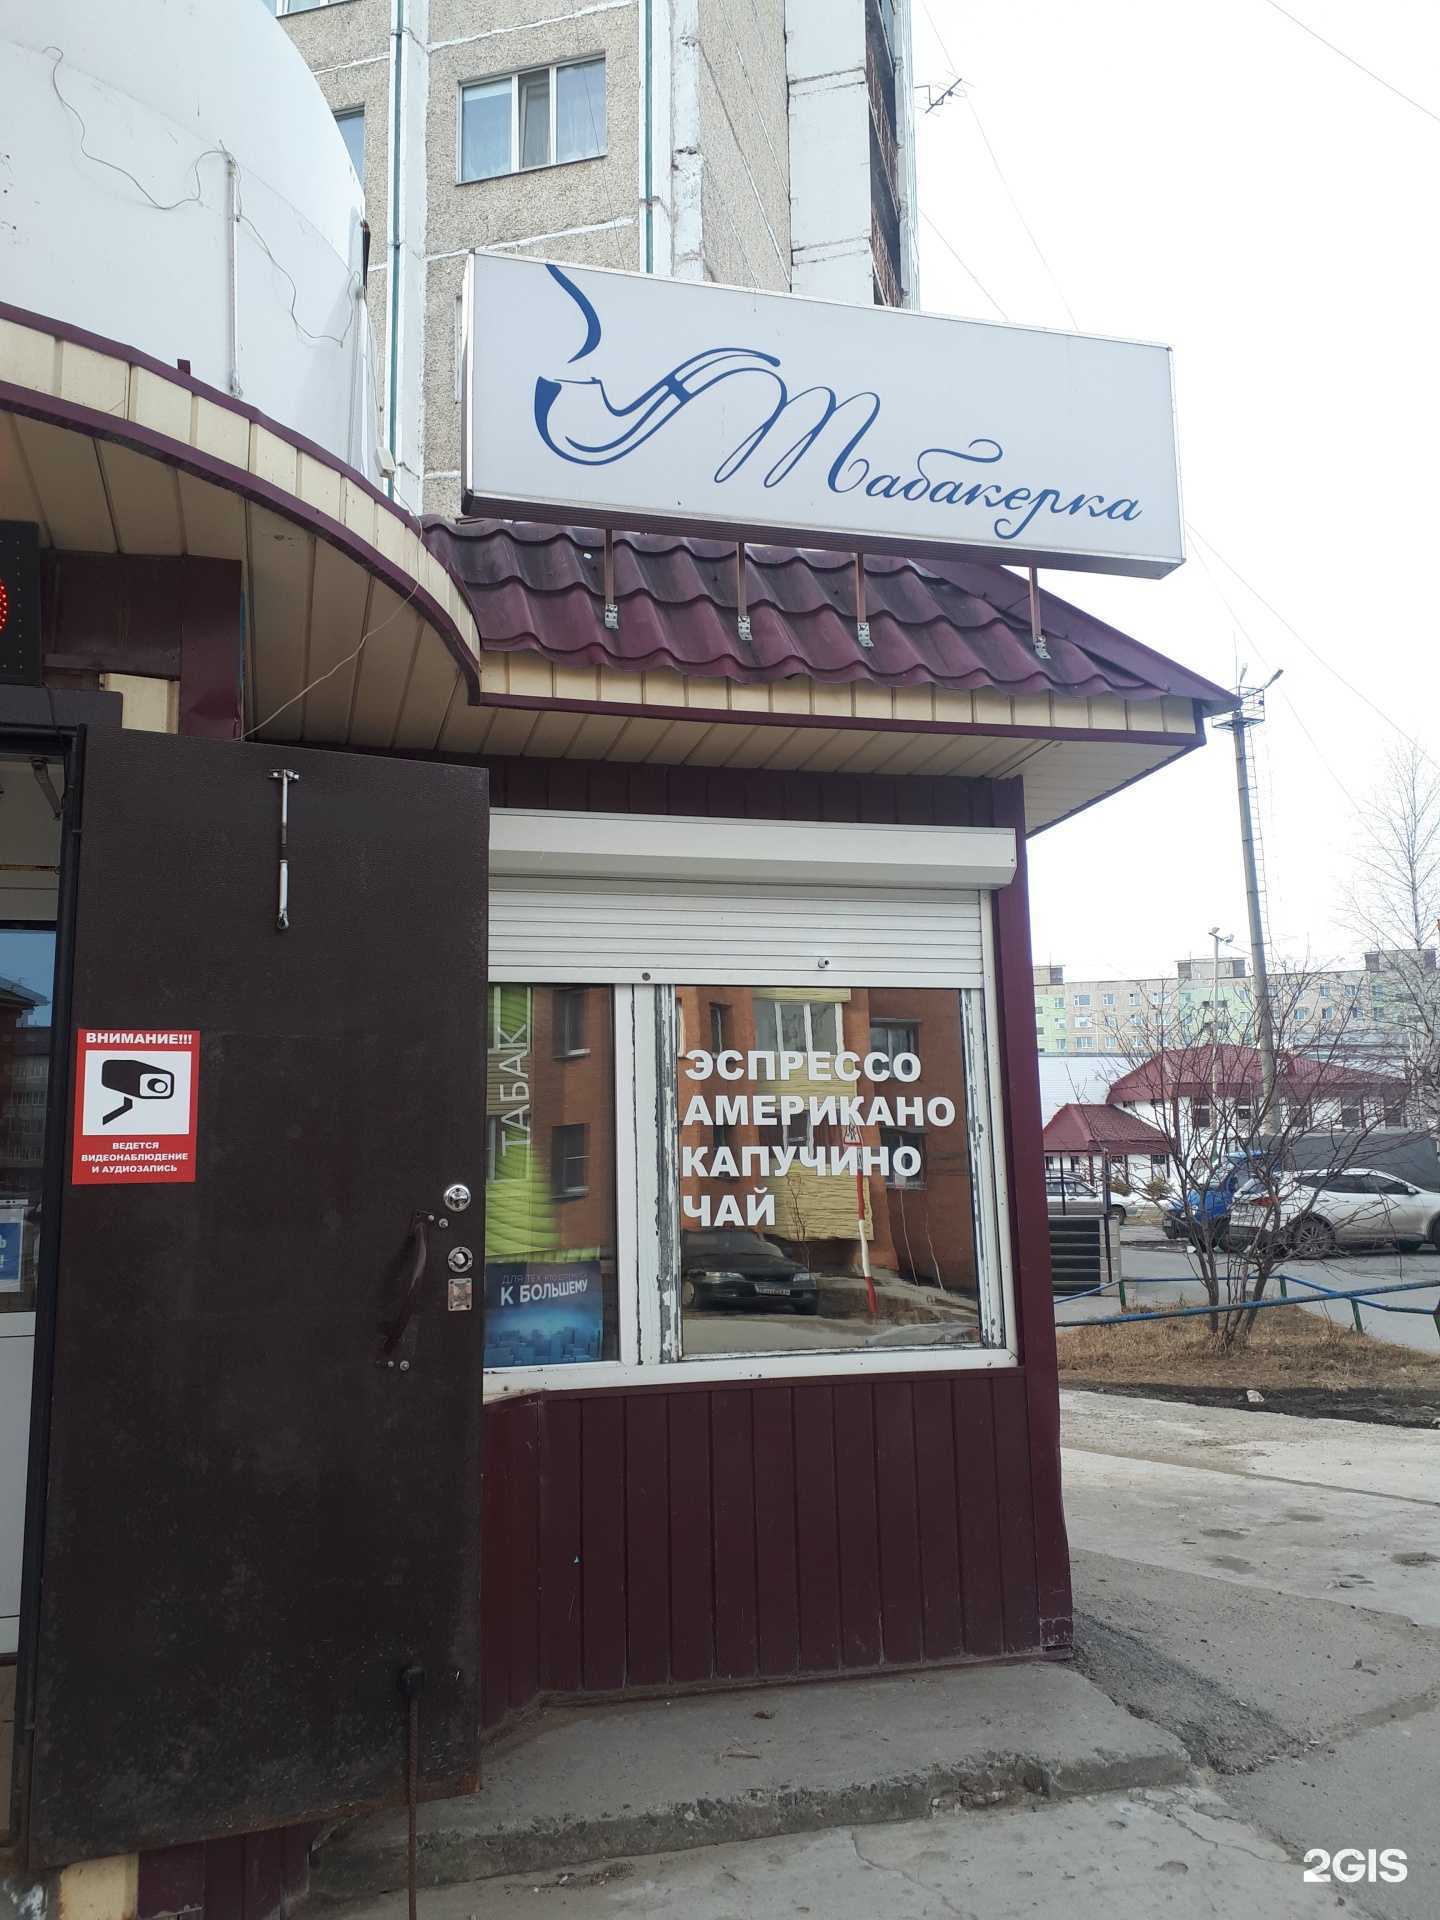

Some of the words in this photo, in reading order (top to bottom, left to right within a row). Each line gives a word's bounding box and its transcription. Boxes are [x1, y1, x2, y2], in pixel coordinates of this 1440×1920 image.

[714, 384, 1144, 540] Табакерка
[86, 1033, 192, 1044] ВНИМАНИЕ!!!
[684, 1049, 922, 1083] ЭСПРЕССО
[497, 1023, 531, 1157] ТАБАК
[682, 1095, 956, 1127] АМЕРИКАНО
[82, 1153, 188, 1162] ВИДЕОНАБЛЮДЕНИЕ
[113, 1142, 159, 1150] ВЕДЕТСЯ
[682, 1145, 922, 1177] КАПУЧИНО
[92, 1166, 100, 1174] И
[103, 1165, 177, 1173] АУДИОЗАПИСЬ
[682, 1186, 776, 1227] ЧАЙ
[500, 1286, 514, 1306] К
[519, 1279, 588, 1303] БОЛЬШЕМУ
